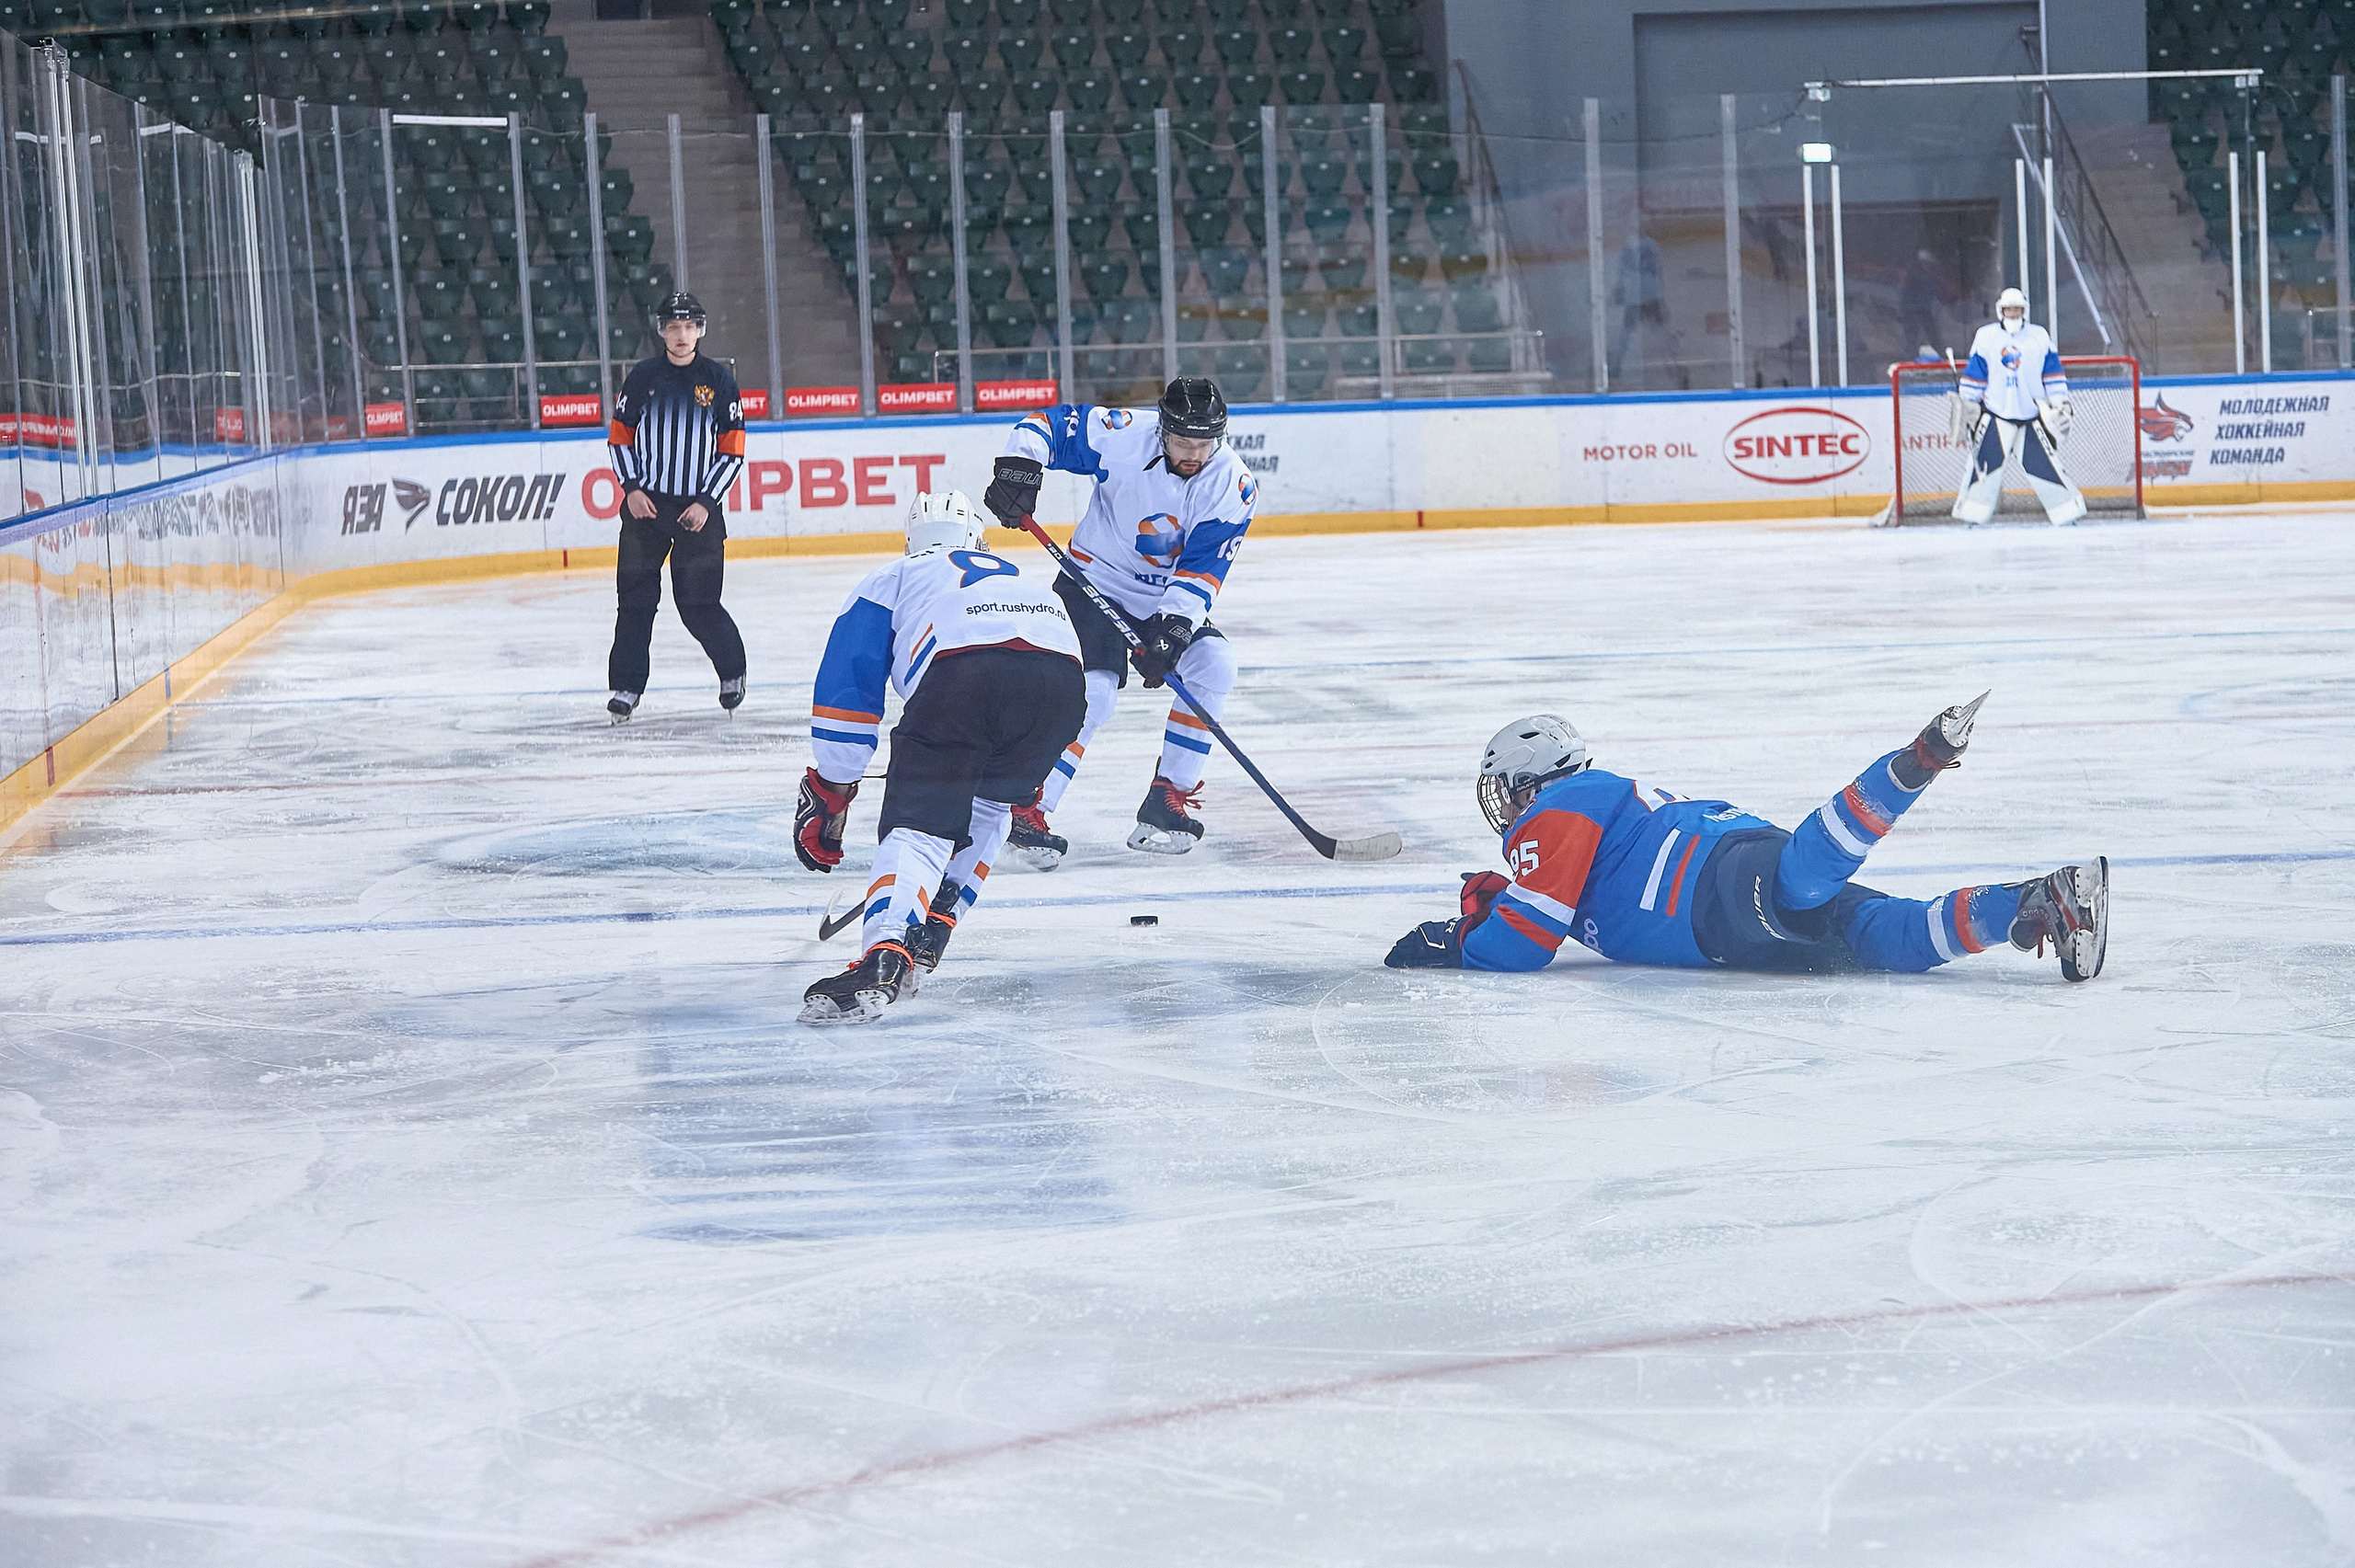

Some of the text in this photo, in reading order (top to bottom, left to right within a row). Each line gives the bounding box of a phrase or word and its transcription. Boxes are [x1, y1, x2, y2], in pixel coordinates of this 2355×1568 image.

[787, 393, 857, 407] OLIMPBET
[880, 389, 954, 405] OLIMPBET
[980, 386, 1054, 402] OLIMPBET
[543, 402, 599, 417] OLIMPBET
[729, 399, 743, 421] 84
[2219, 395, 2329, 416] МОЛОДЕЖНАЯ
[367, 411, 403, 425] OLIMPBET
[2214, 420, 2305, 441] ХОККЕЙНАЯ
[1583, 442, 1698, 461] MOTOR OIL
[1733, 433, 1860, 458] SINTEC
[2210, 447, 2285, 465] КОМАНДА
[436, 473, 567, 526] СОКОЛ!
[966, 601, 1067, 621] sport.rushydro.ru
